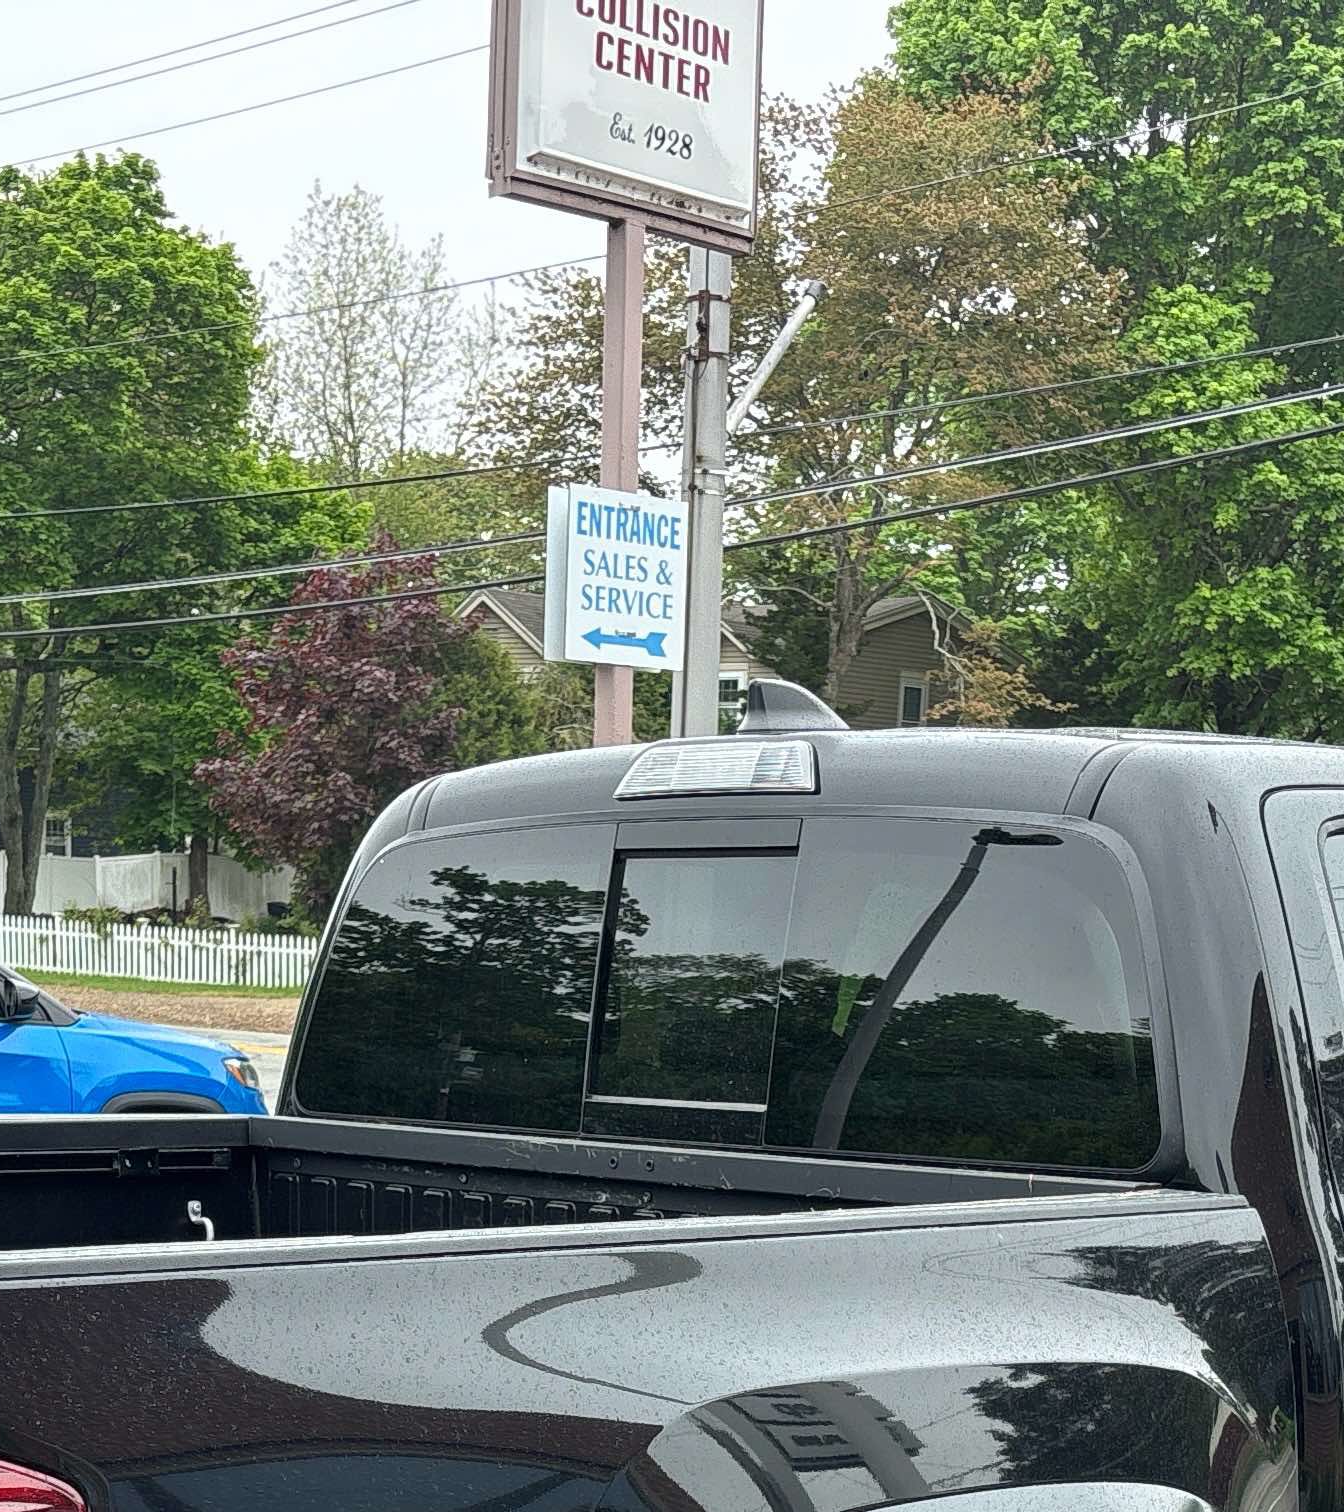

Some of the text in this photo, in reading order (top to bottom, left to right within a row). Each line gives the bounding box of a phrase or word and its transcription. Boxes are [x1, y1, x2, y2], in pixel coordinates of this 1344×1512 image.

[595, 31, 711, 103] CENTER
[610, 112, 693, 160] Est. 1928
[576, 501, 681, 550] ENTRANCE
[583, 549, 673, 586] SALES &
[580, 583, 674, 620] SERVICE
